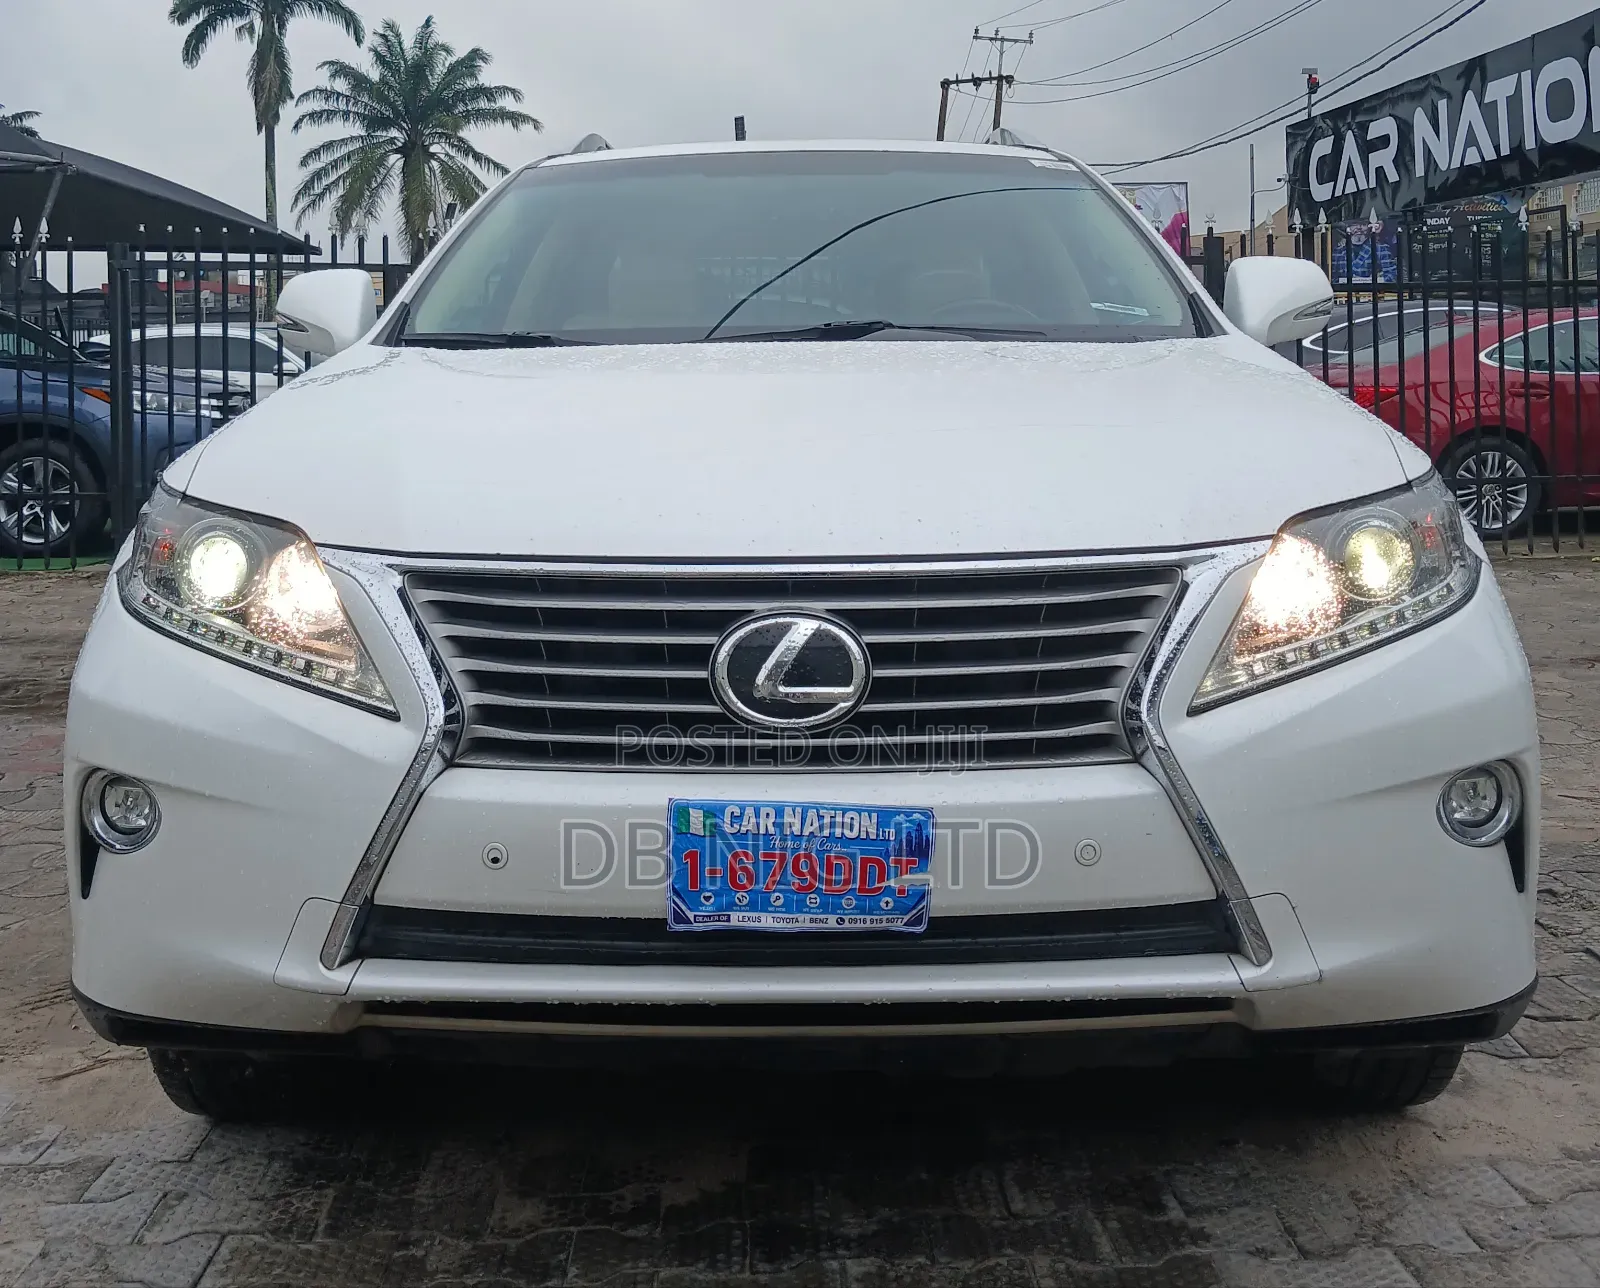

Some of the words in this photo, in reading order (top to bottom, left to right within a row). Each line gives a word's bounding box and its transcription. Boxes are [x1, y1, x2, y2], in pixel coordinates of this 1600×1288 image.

[1308, 116, 1400, 202] CAR
[1413, 46, 1600, 178] NATIO
[723, 805, 777, 834] CAR
[783, 806, 877, 840] NATION
[879, 828, 896, 840] LTD
[769, 836, 801, 849] Home
[803, 838, 816, 852] of
[682, 848, 919, 897] 1-679DDT
[737, 915, 762, 923] LEXUS
[771, 916, 800, 924] TOYOTA
[848, 917, 867, 925] 0916
[869, 917, 884, 925] 915
[885, 916, 905, 924] 5077
